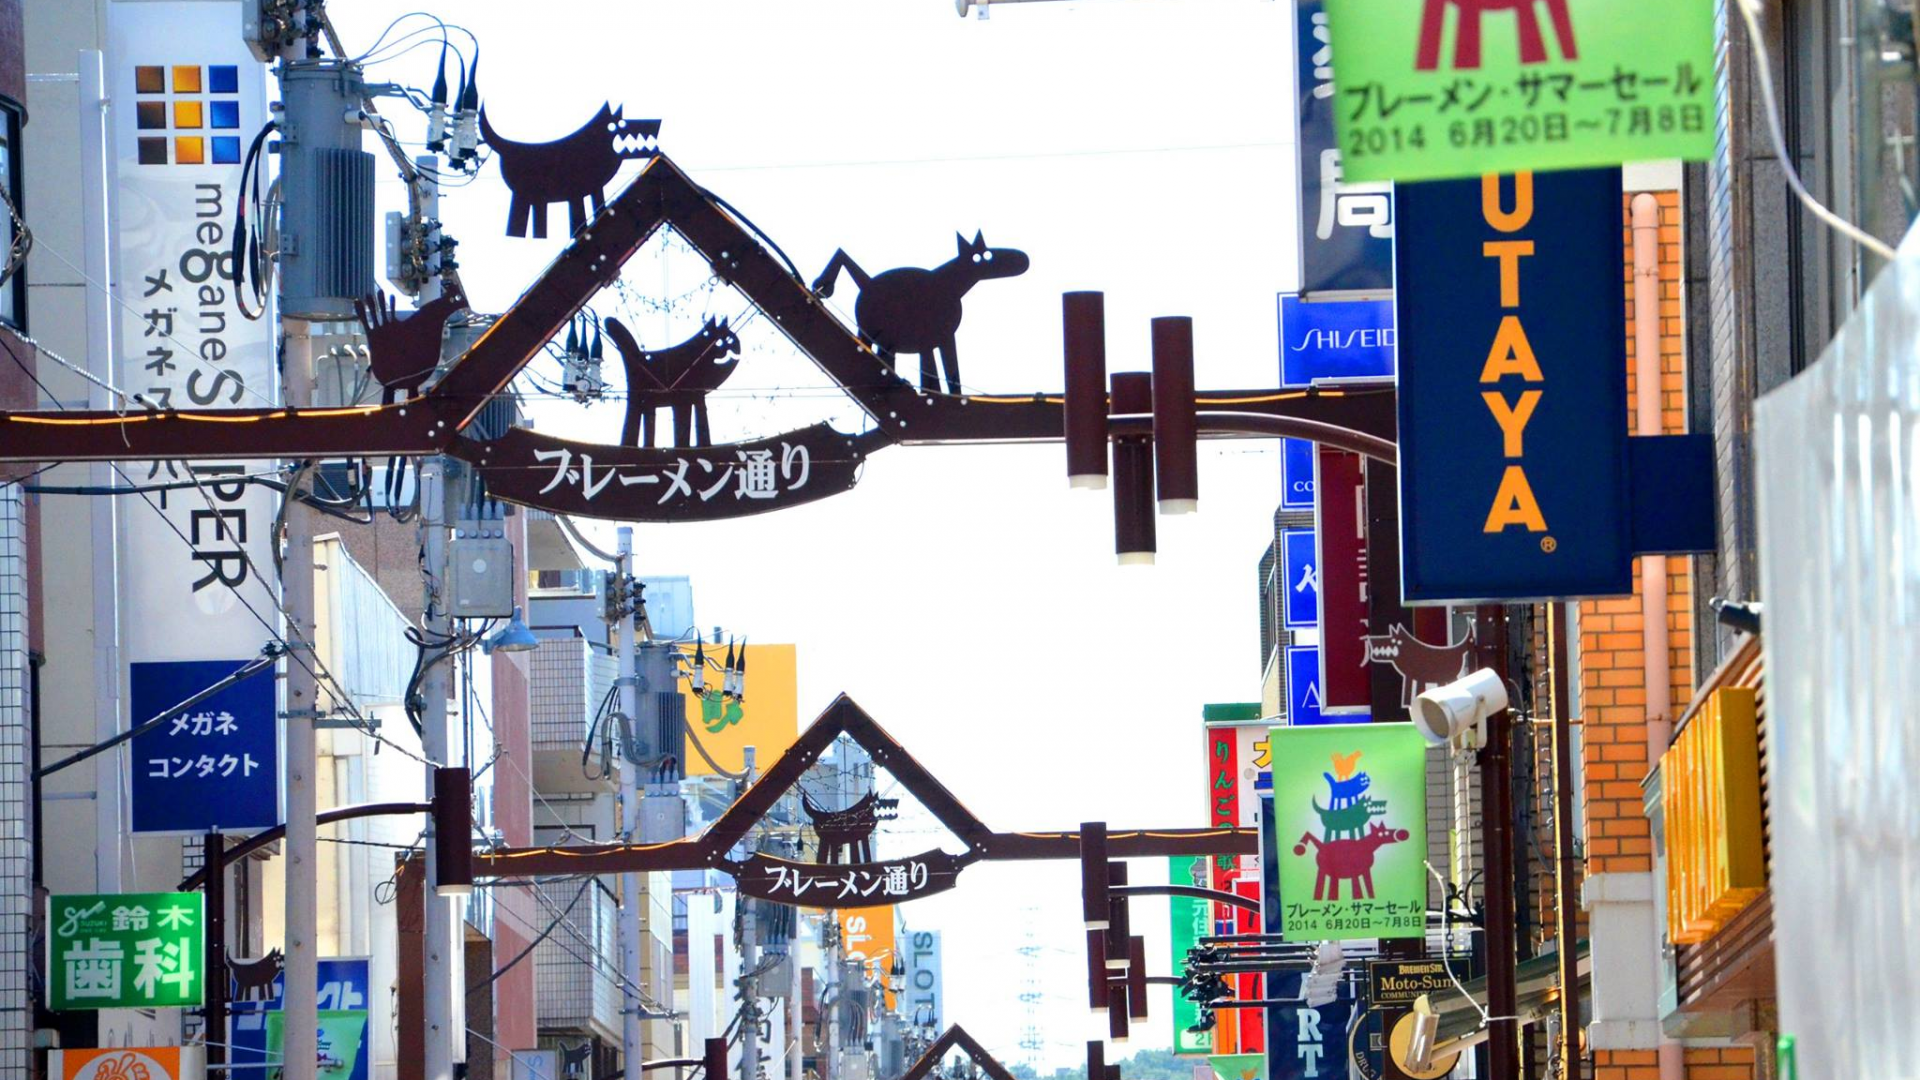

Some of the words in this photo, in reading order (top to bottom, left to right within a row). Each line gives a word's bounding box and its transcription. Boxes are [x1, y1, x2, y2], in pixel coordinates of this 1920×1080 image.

[1349, 125, 1427, 157] 2014
[533, 441, 811, 505] ブレーメン通り
[168, 710, 239, 736] メガネ
[148, 751, 260, 779] コンタクト
[763, 861, 929, 900] ブレーメン通り
[111, 904, 195, 932] 鈴木
[1286, 900, 1422, 918] ブレーメン・サマーセール
[1288, 919, 1318, 931] 2014
[63, 937, 195, 1000] 歯科
